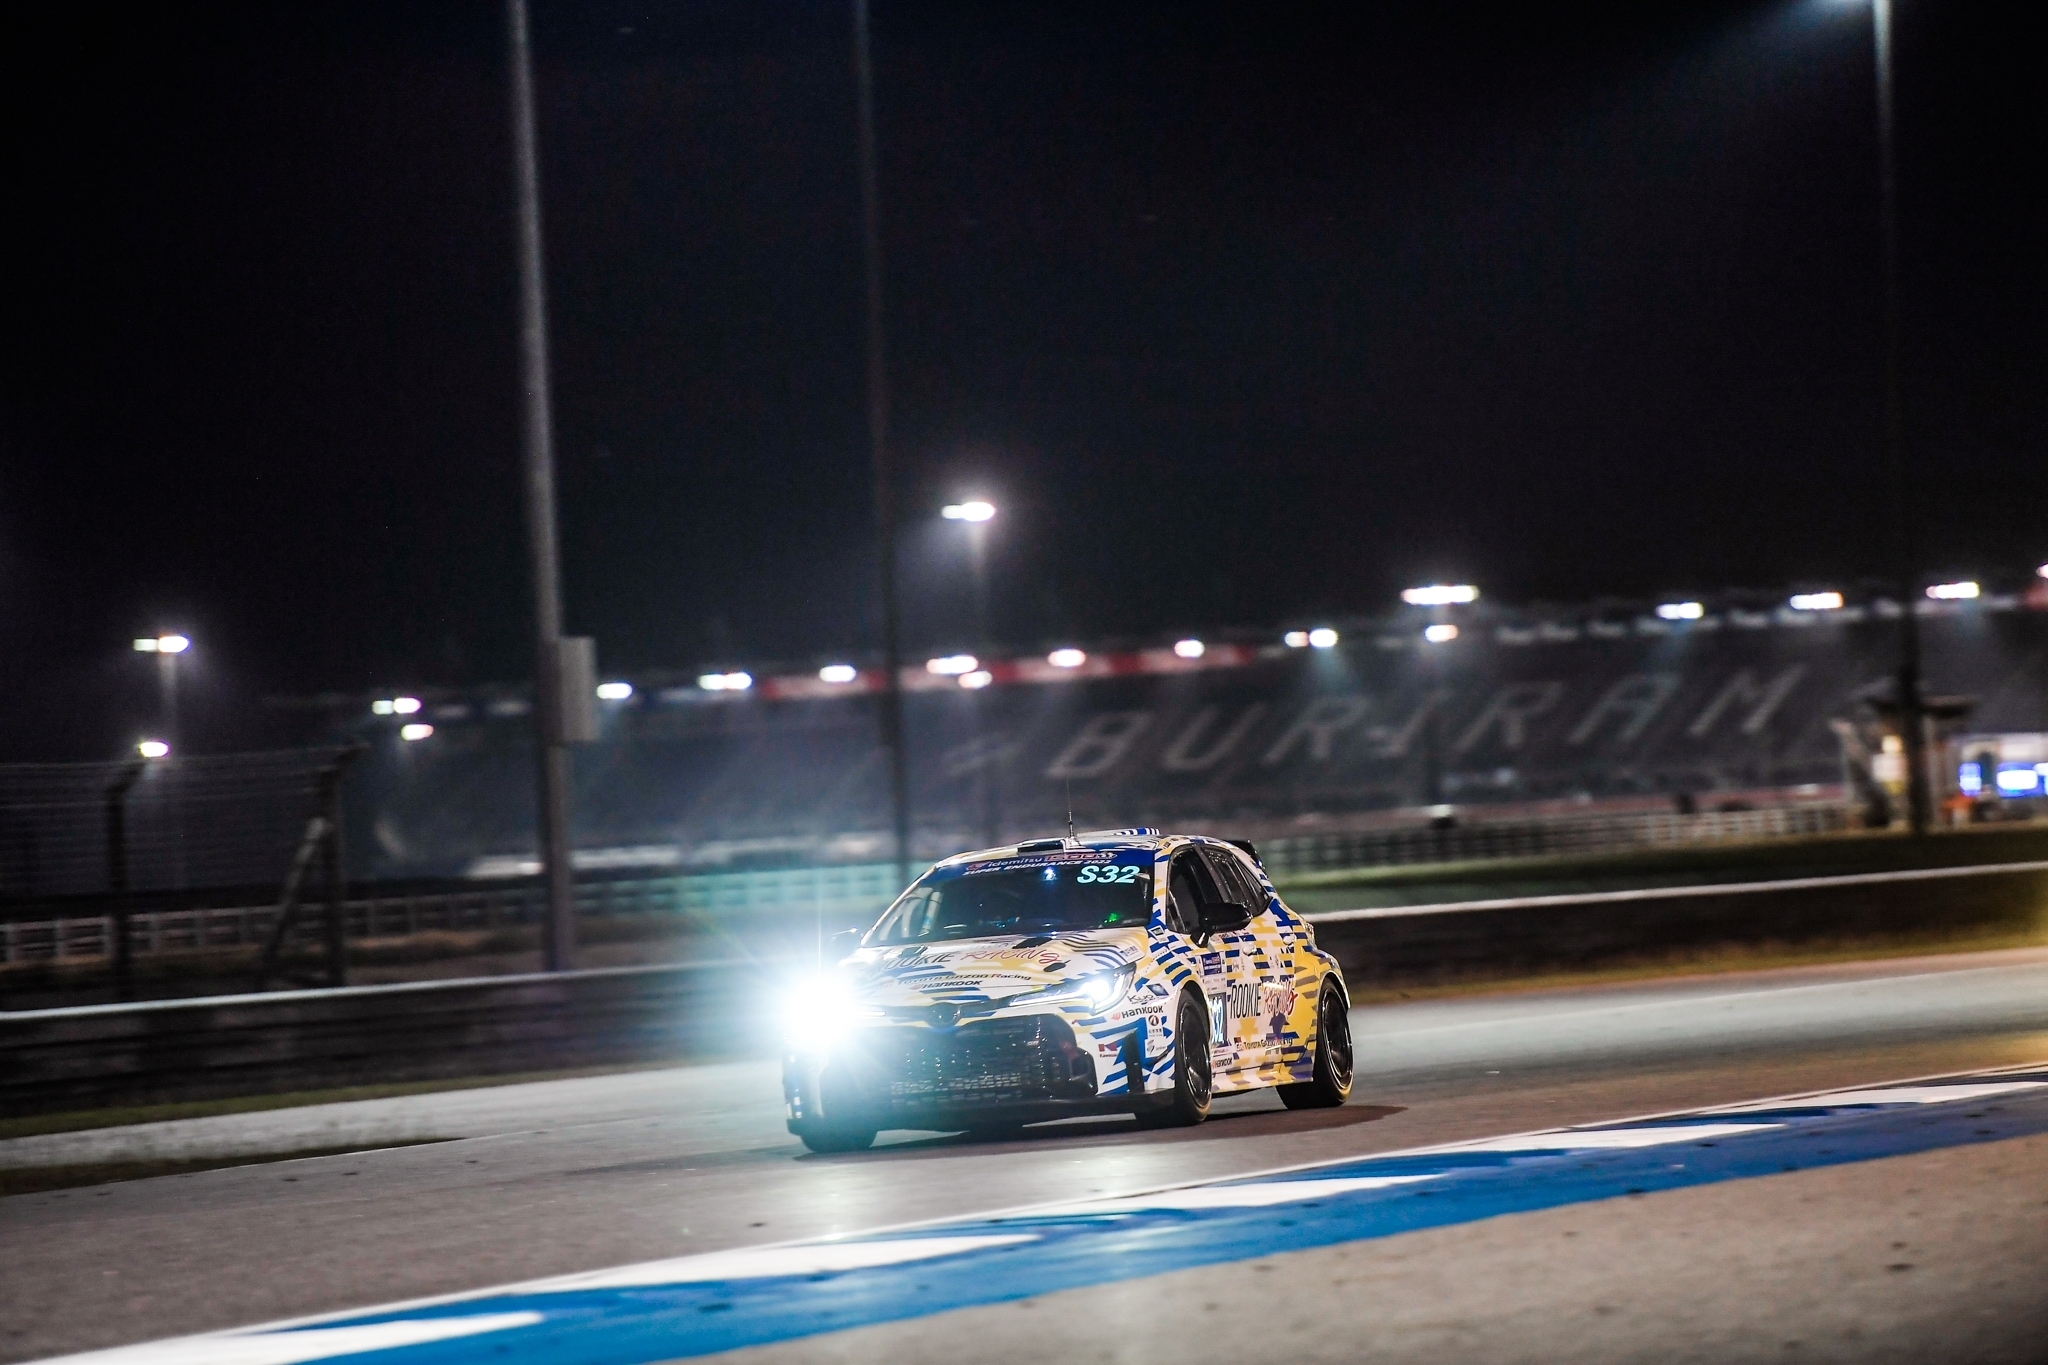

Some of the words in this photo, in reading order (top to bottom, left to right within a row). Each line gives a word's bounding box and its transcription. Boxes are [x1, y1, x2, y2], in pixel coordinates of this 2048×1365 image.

[962, 866, 1002, 876] SUPER
[1003, 860, 1081, 870] ENDURANCE
[987, 857, 1042, 868] idemitsu
[1076, 865, 1141, 884] S32
[1229, 982, 1262, 1019] ROOKIE
